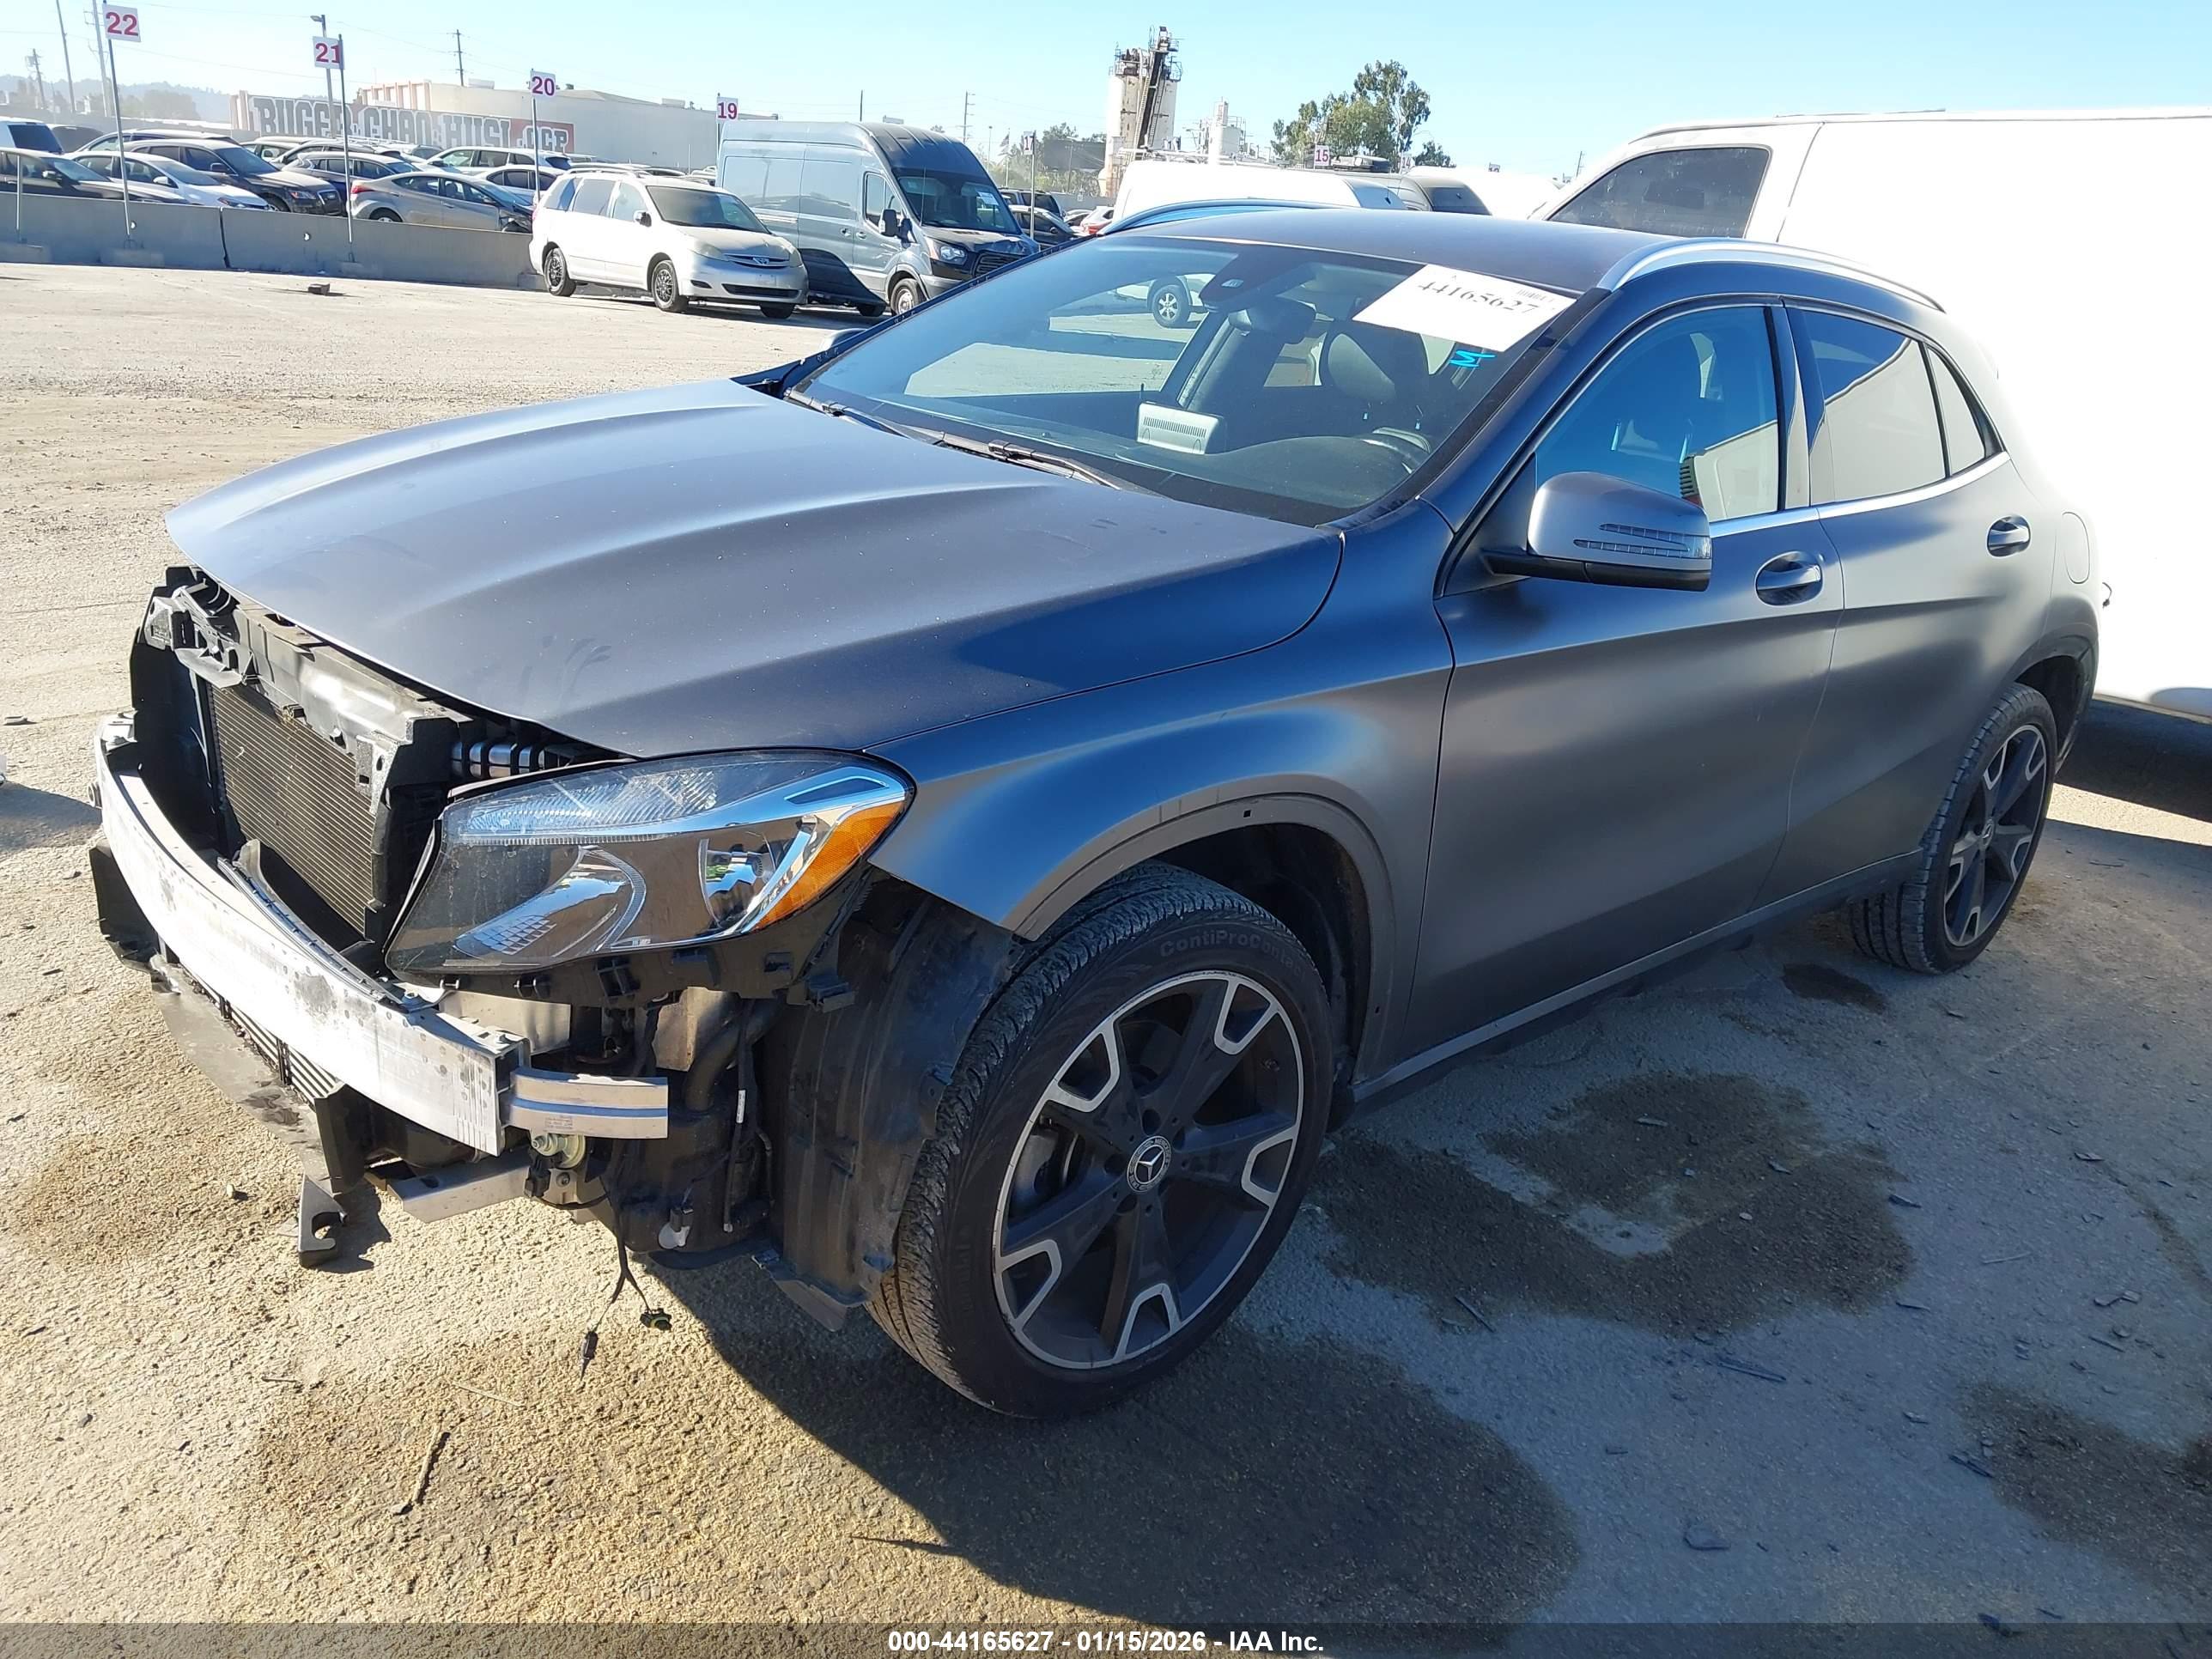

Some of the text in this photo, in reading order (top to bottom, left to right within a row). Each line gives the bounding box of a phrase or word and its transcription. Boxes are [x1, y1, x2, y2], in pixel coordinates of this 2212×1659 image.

[106, 11, 139, 37] 22
[315, 43, 341, 64] 21
[532, 76, 555, 96] 20
[717, 101, 738, 120] 19
[1315, 149, 1329, 162] 15
[1418, 281, 1540, 314] 44165627
